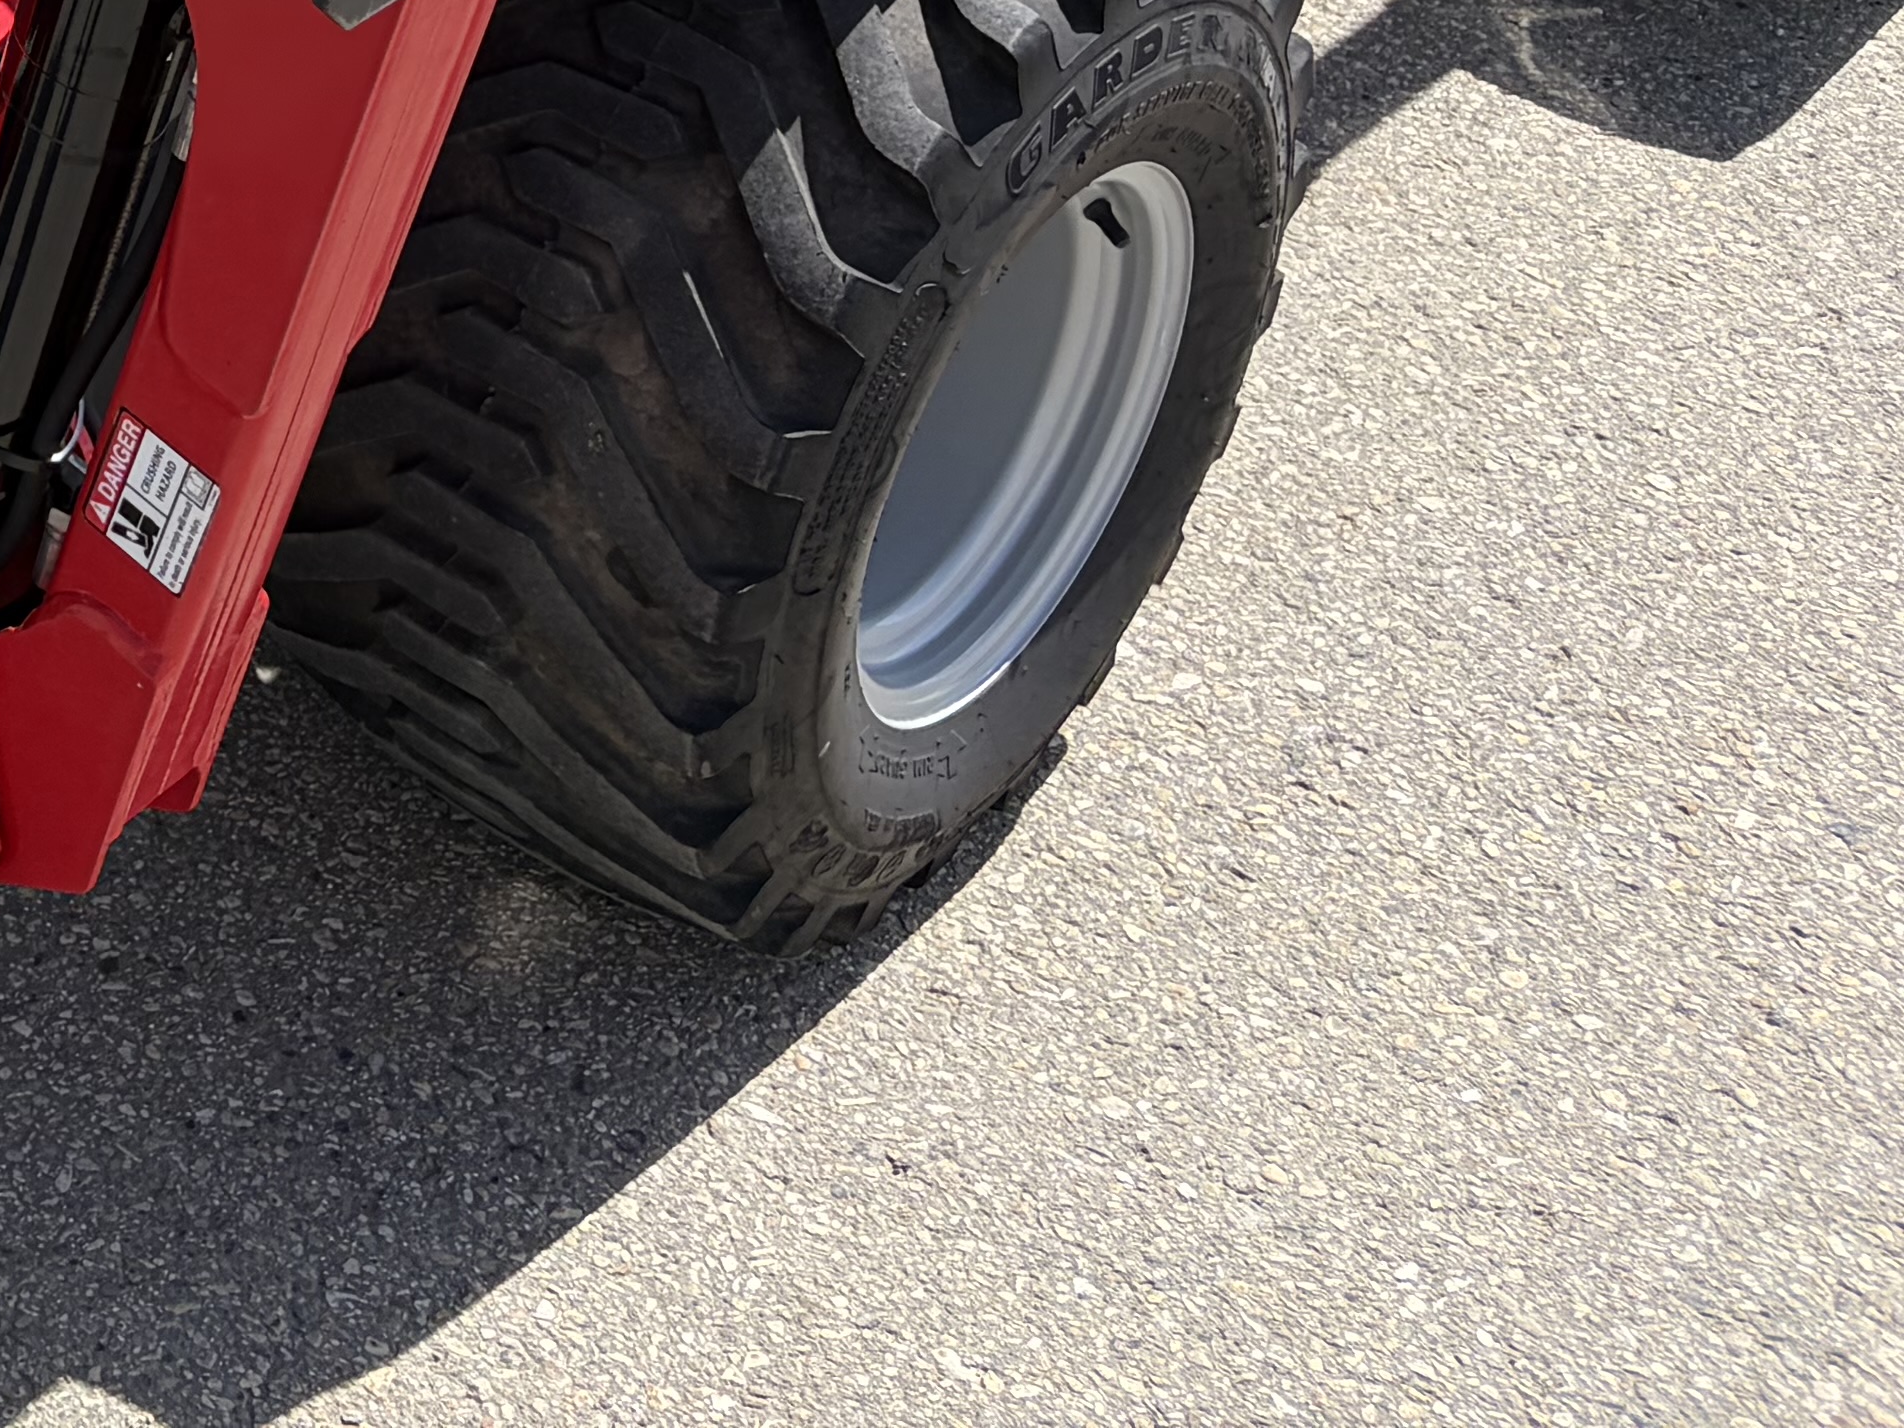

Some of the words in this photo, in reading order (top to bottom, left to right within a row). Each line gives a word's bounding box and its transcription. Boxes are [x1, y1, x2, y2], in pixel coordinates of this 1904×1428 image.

[97, 418, 142, 502] DANGER
[140, 444, 166, 494] CRUSHING
[155, 460, 177, 502] HAZARD
